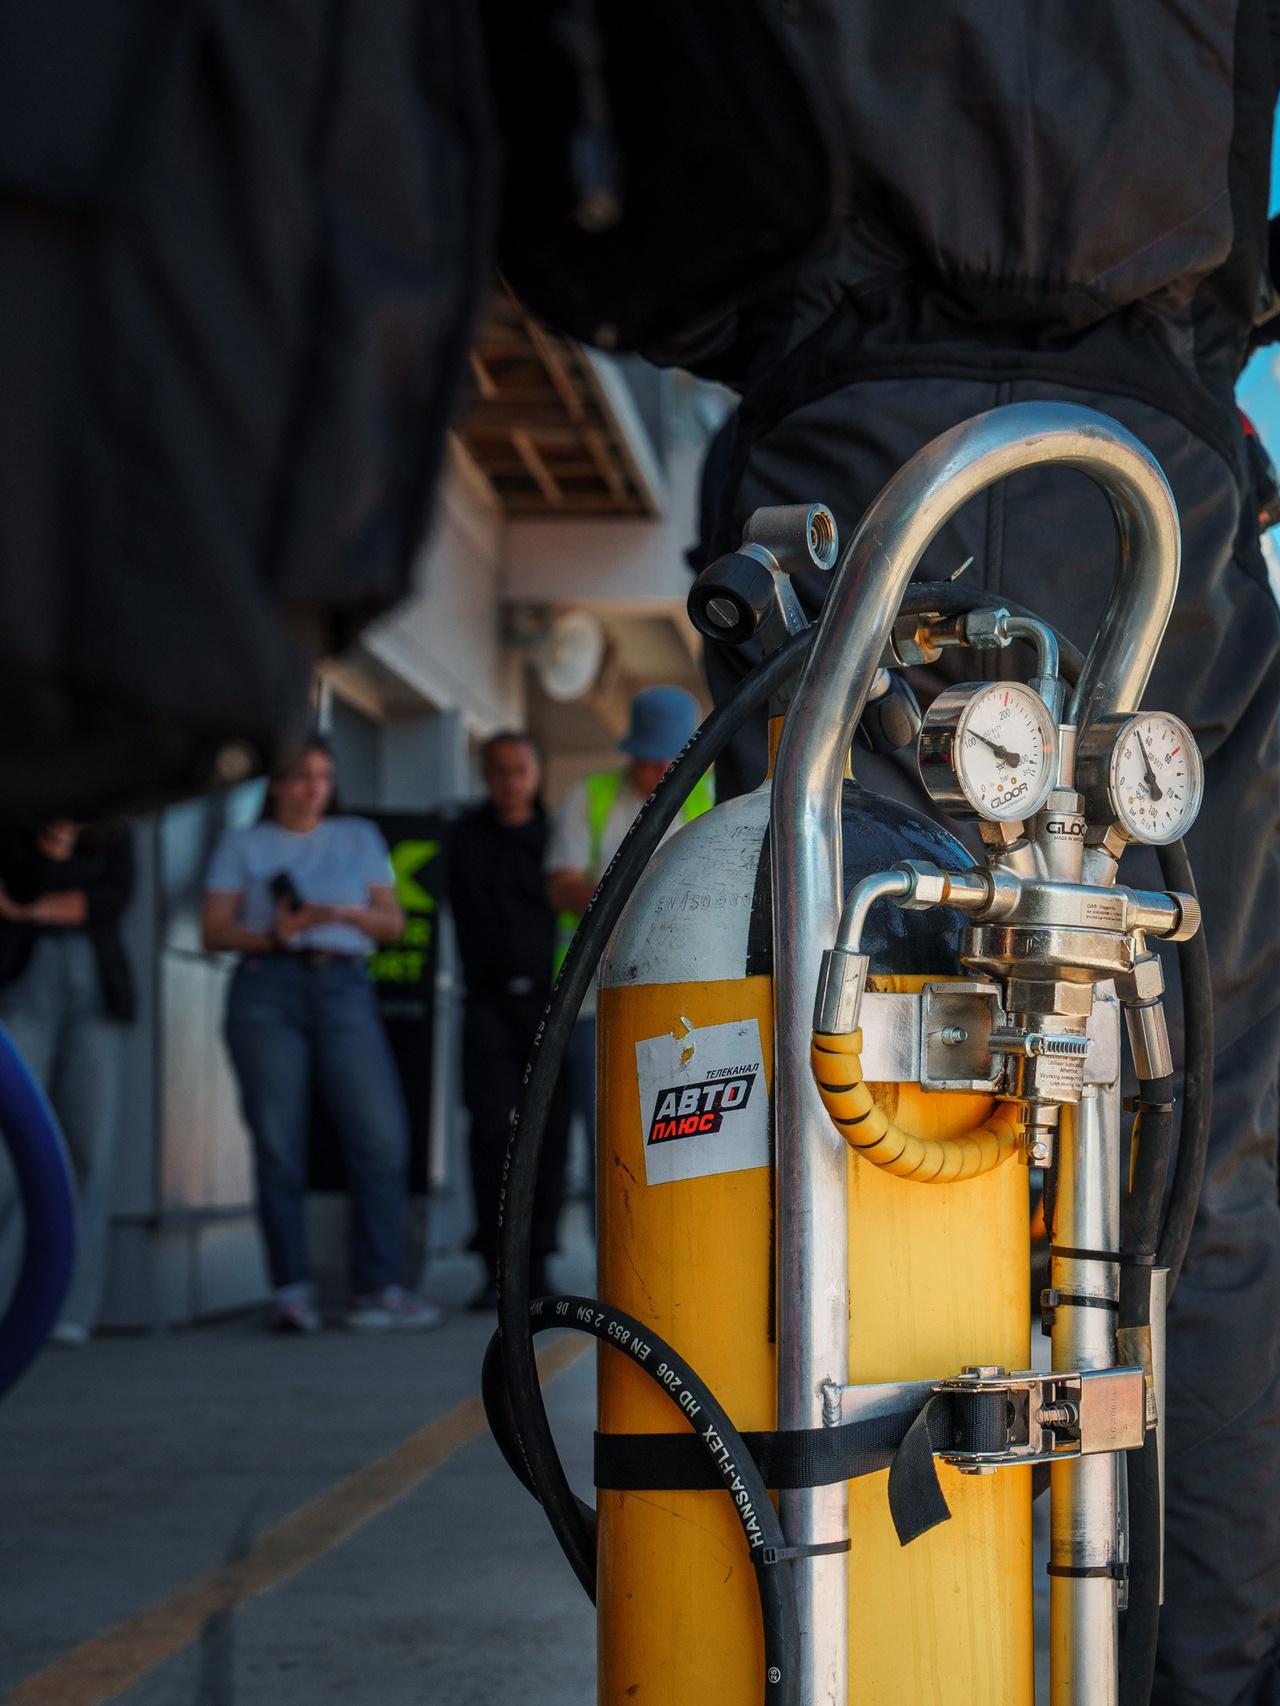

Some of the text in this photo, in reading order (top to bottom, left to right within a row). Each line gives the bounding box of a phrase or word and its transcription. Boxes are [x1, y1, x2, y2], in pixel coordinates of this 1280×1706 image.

[999, 708, 1011, 721] 200
[964, 737, 977, 749] 100
[1145, 736, 1153, 747] 40
[1123, 749, 1132, 760] 20
[990, 782, 1028, 809] GLOOR
[1148, 804, 1158, 818] 100
[706, 1062, 760, 1080] ТЕЛЕКАНАЛ
[656, 1080, 748, 1121] АВТО
[652, 1113, 715, 1141] ПЛЮС
[555, 1301, 570, 1316] 06
[576, 1306, 594, 1323] SN
[594, 1313, 605, 1328] 2
[607, 1321, 631, 1344] 853
[630, 1337, 652, 1362] EN
[656, 1363, 682, 1392] 206
[679, 1390, 702, 1418] HD
[702, 1424, 764, 1549] HANSA-FLEX
